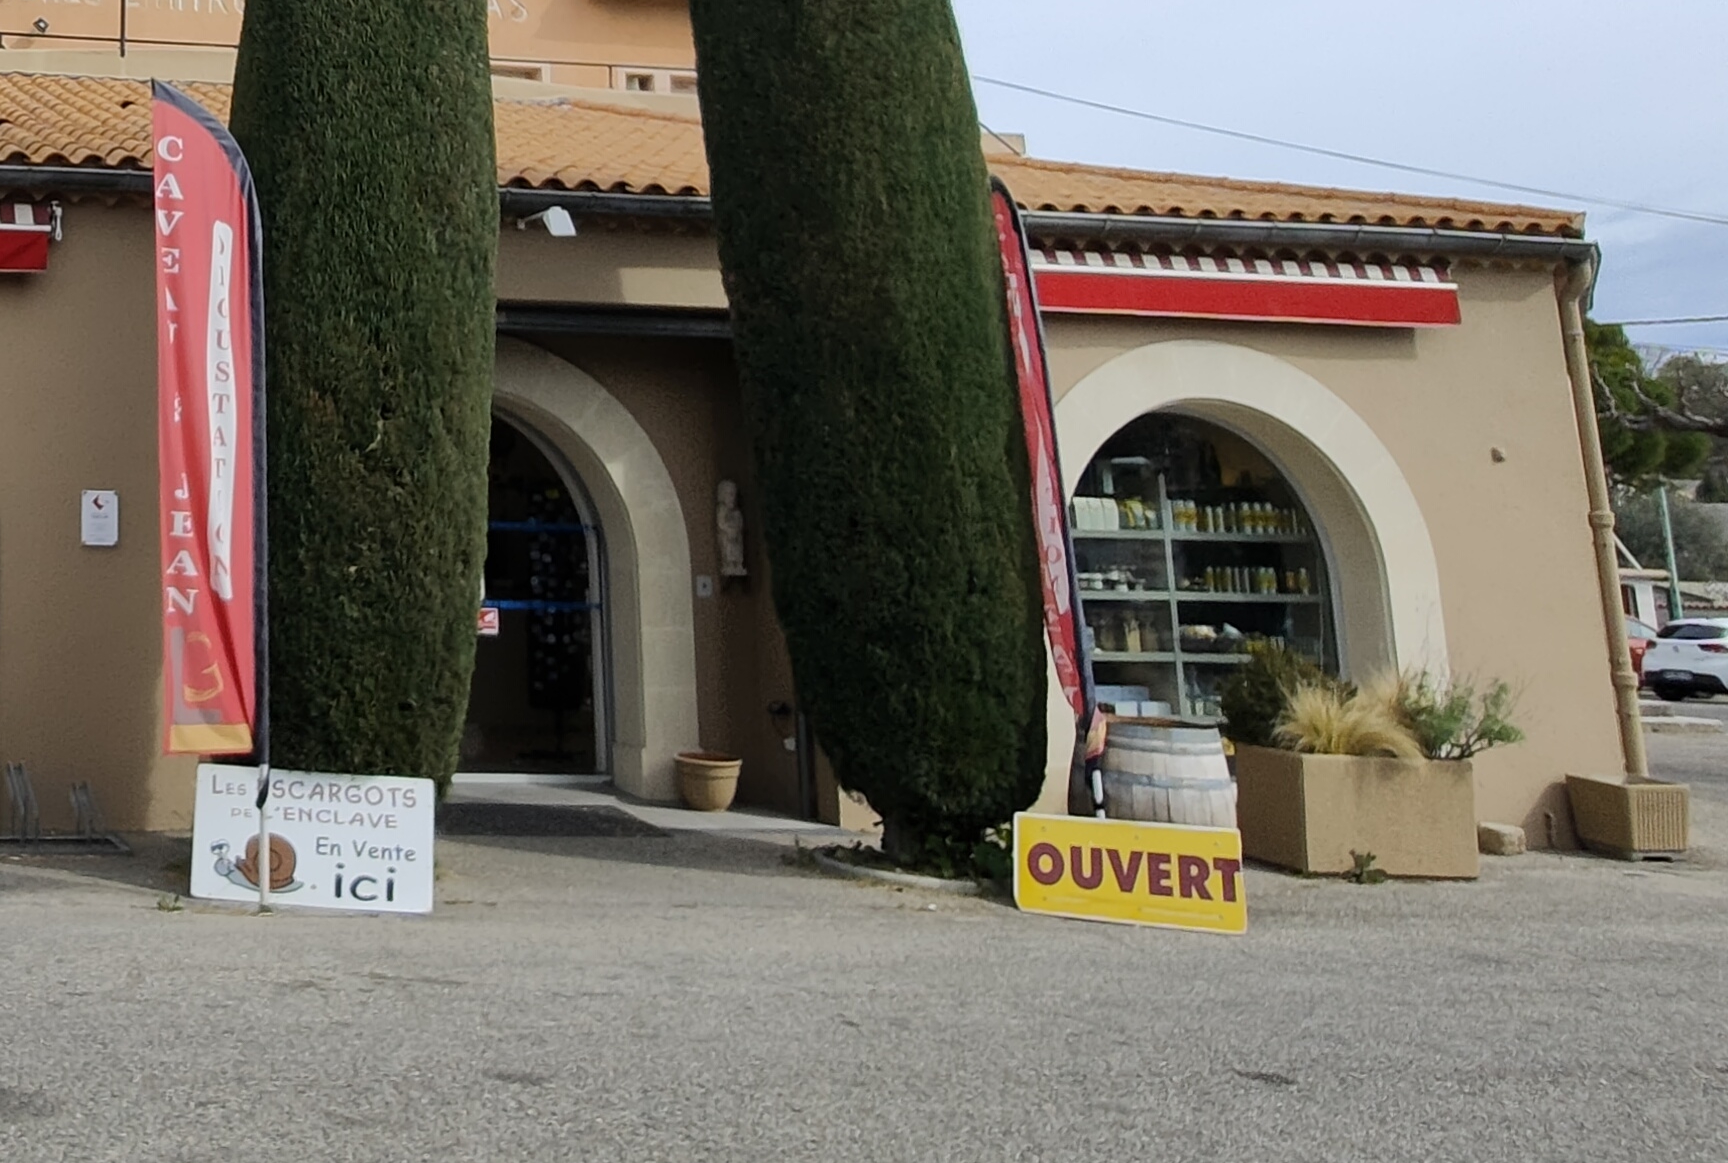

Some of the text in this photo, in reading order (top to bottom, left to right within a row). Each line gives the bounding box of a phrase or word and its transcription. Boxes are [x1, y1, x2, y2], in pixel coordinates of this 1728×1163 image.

[166, 471, 198, 615] JEAN
[211, 774, 418, 809] LES SCARGOTS
[315, 836, 417, 862] En Vente
[1027, 841, 1241, 903] OUVERT
